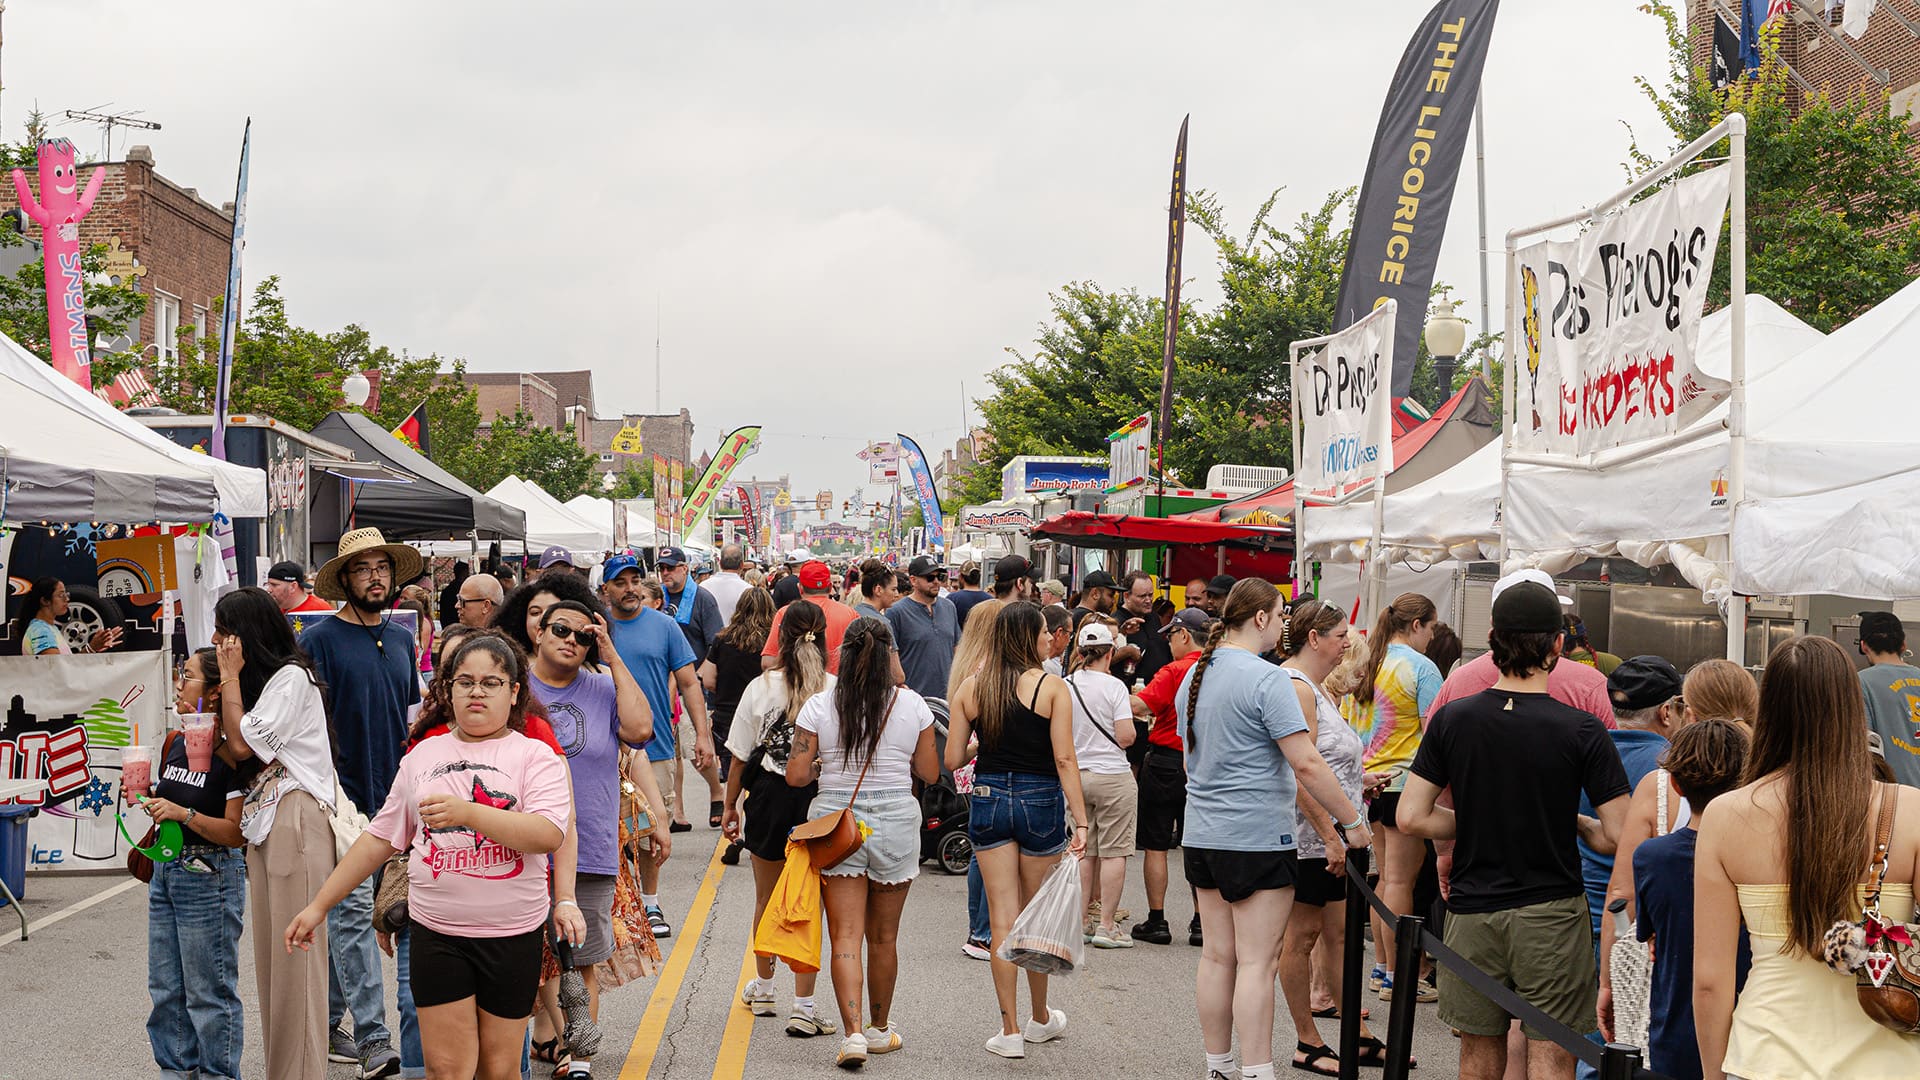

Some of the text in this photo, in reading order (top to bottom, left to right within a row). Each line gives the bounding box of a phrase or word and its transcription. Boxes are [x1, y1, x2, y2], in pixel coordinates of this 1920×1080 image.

[1378, 16, 1466, 287] THE LICORICE
[684, 433, 750, 528] TACOS
[1030, 477, 1068, 490] Jumbo
[969, 514, 990, 525] Jumbo
[31, 844, 64, 865] Ice
